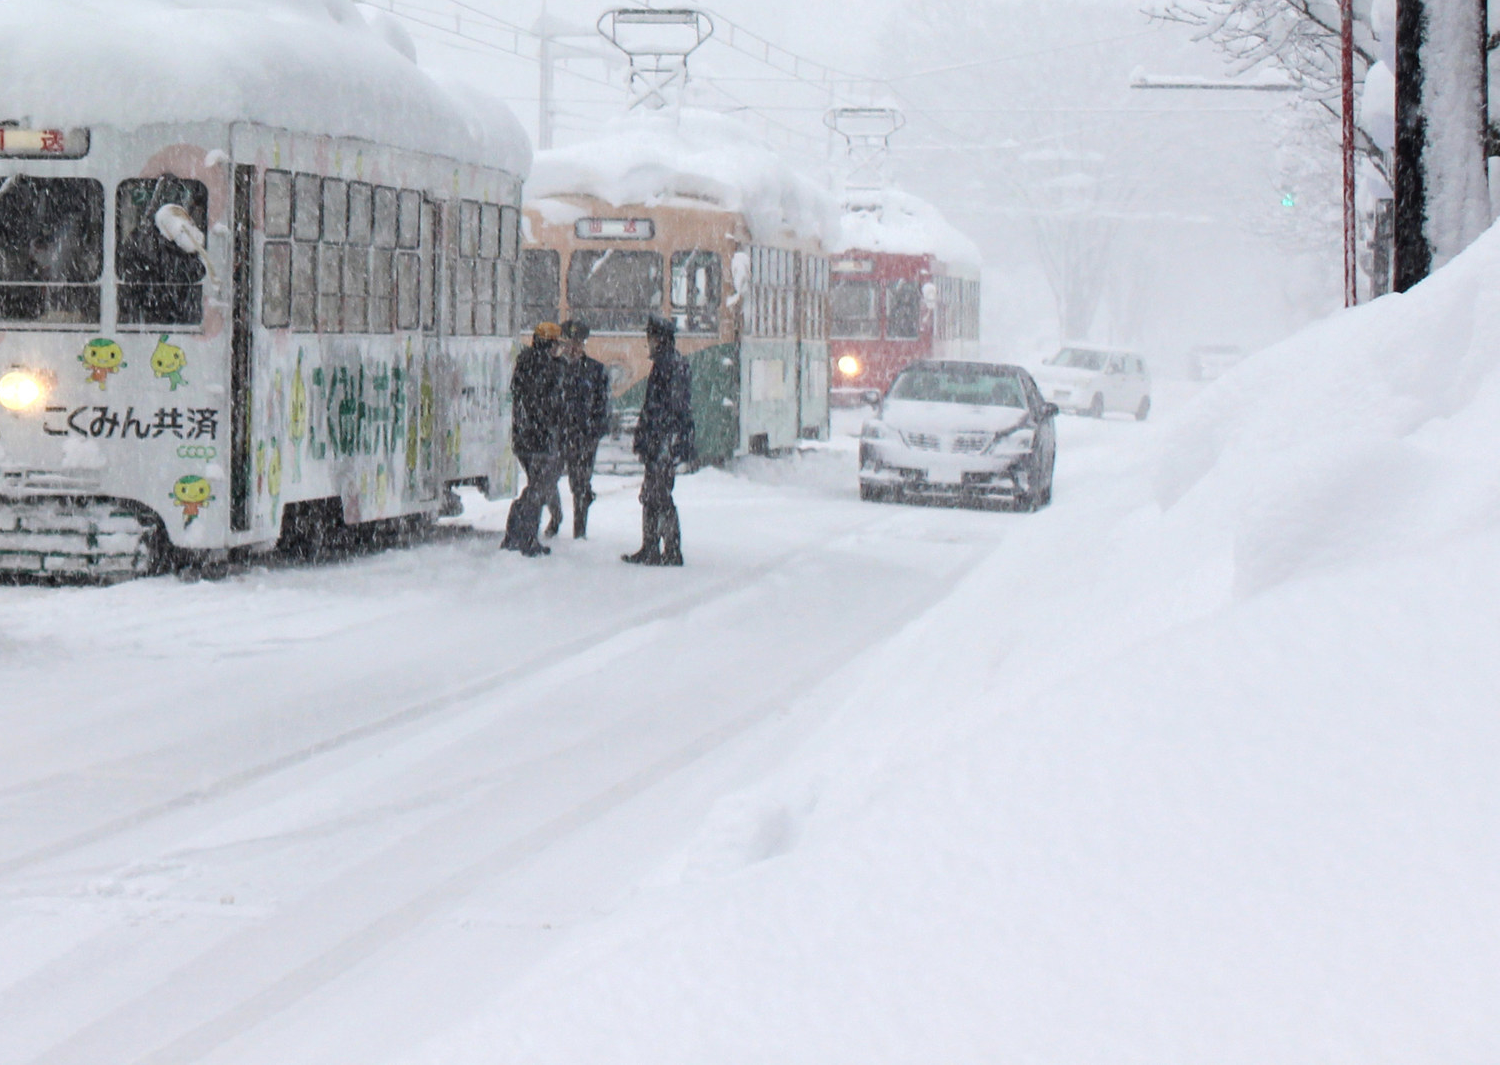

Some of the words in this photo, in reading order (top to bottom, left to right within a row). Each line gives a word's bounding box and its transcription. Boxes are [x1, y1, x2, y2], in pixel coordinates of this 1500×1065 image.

[43, 406, 218, 440] こくみん共済
